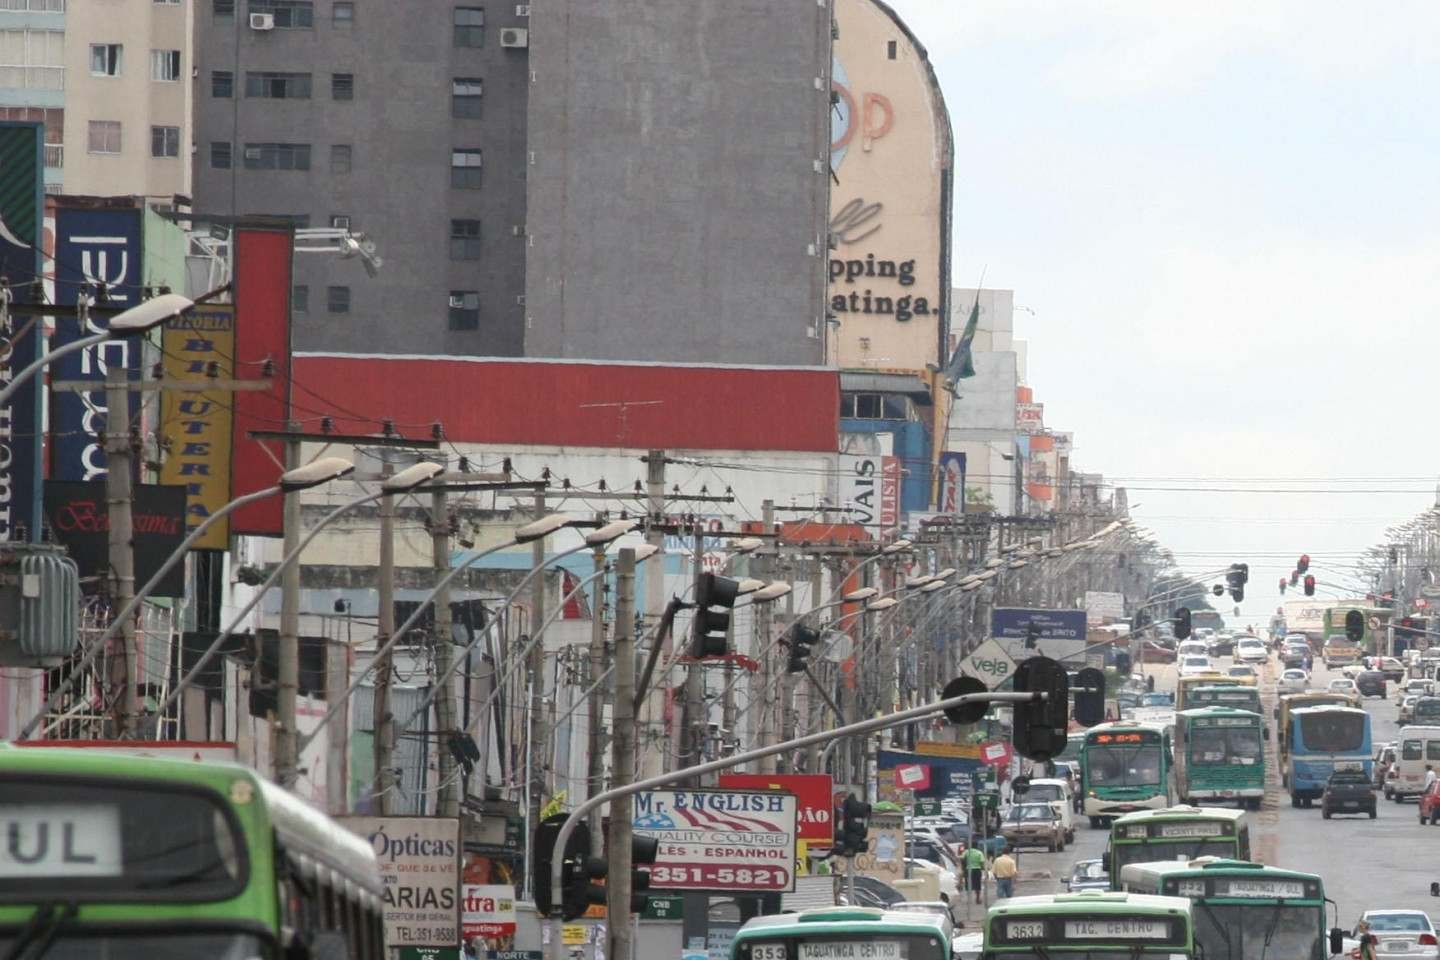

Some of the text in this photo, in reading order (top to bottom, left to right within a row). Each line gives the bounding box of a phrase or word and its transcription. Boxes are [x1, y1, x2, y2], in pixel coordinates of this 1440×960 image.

[829, 254, 915, 284] pping
[832, 290, 938, 321] atinga.
[971, 656, 1008, 675] veja
[635, 791, 784, 814] Mr. ENGLISH
[369, 826, 455, 862] Ópticas
[710, 832, 784, 844] COURSE
[704, 847, 788, 861] ESPANHOL
[1106, 922, 1154, 934] CENTRO
[496, 951, 530, 960] NORTE
[754, 943, 895, 960] 353 TAGUATINGA CENTRO
